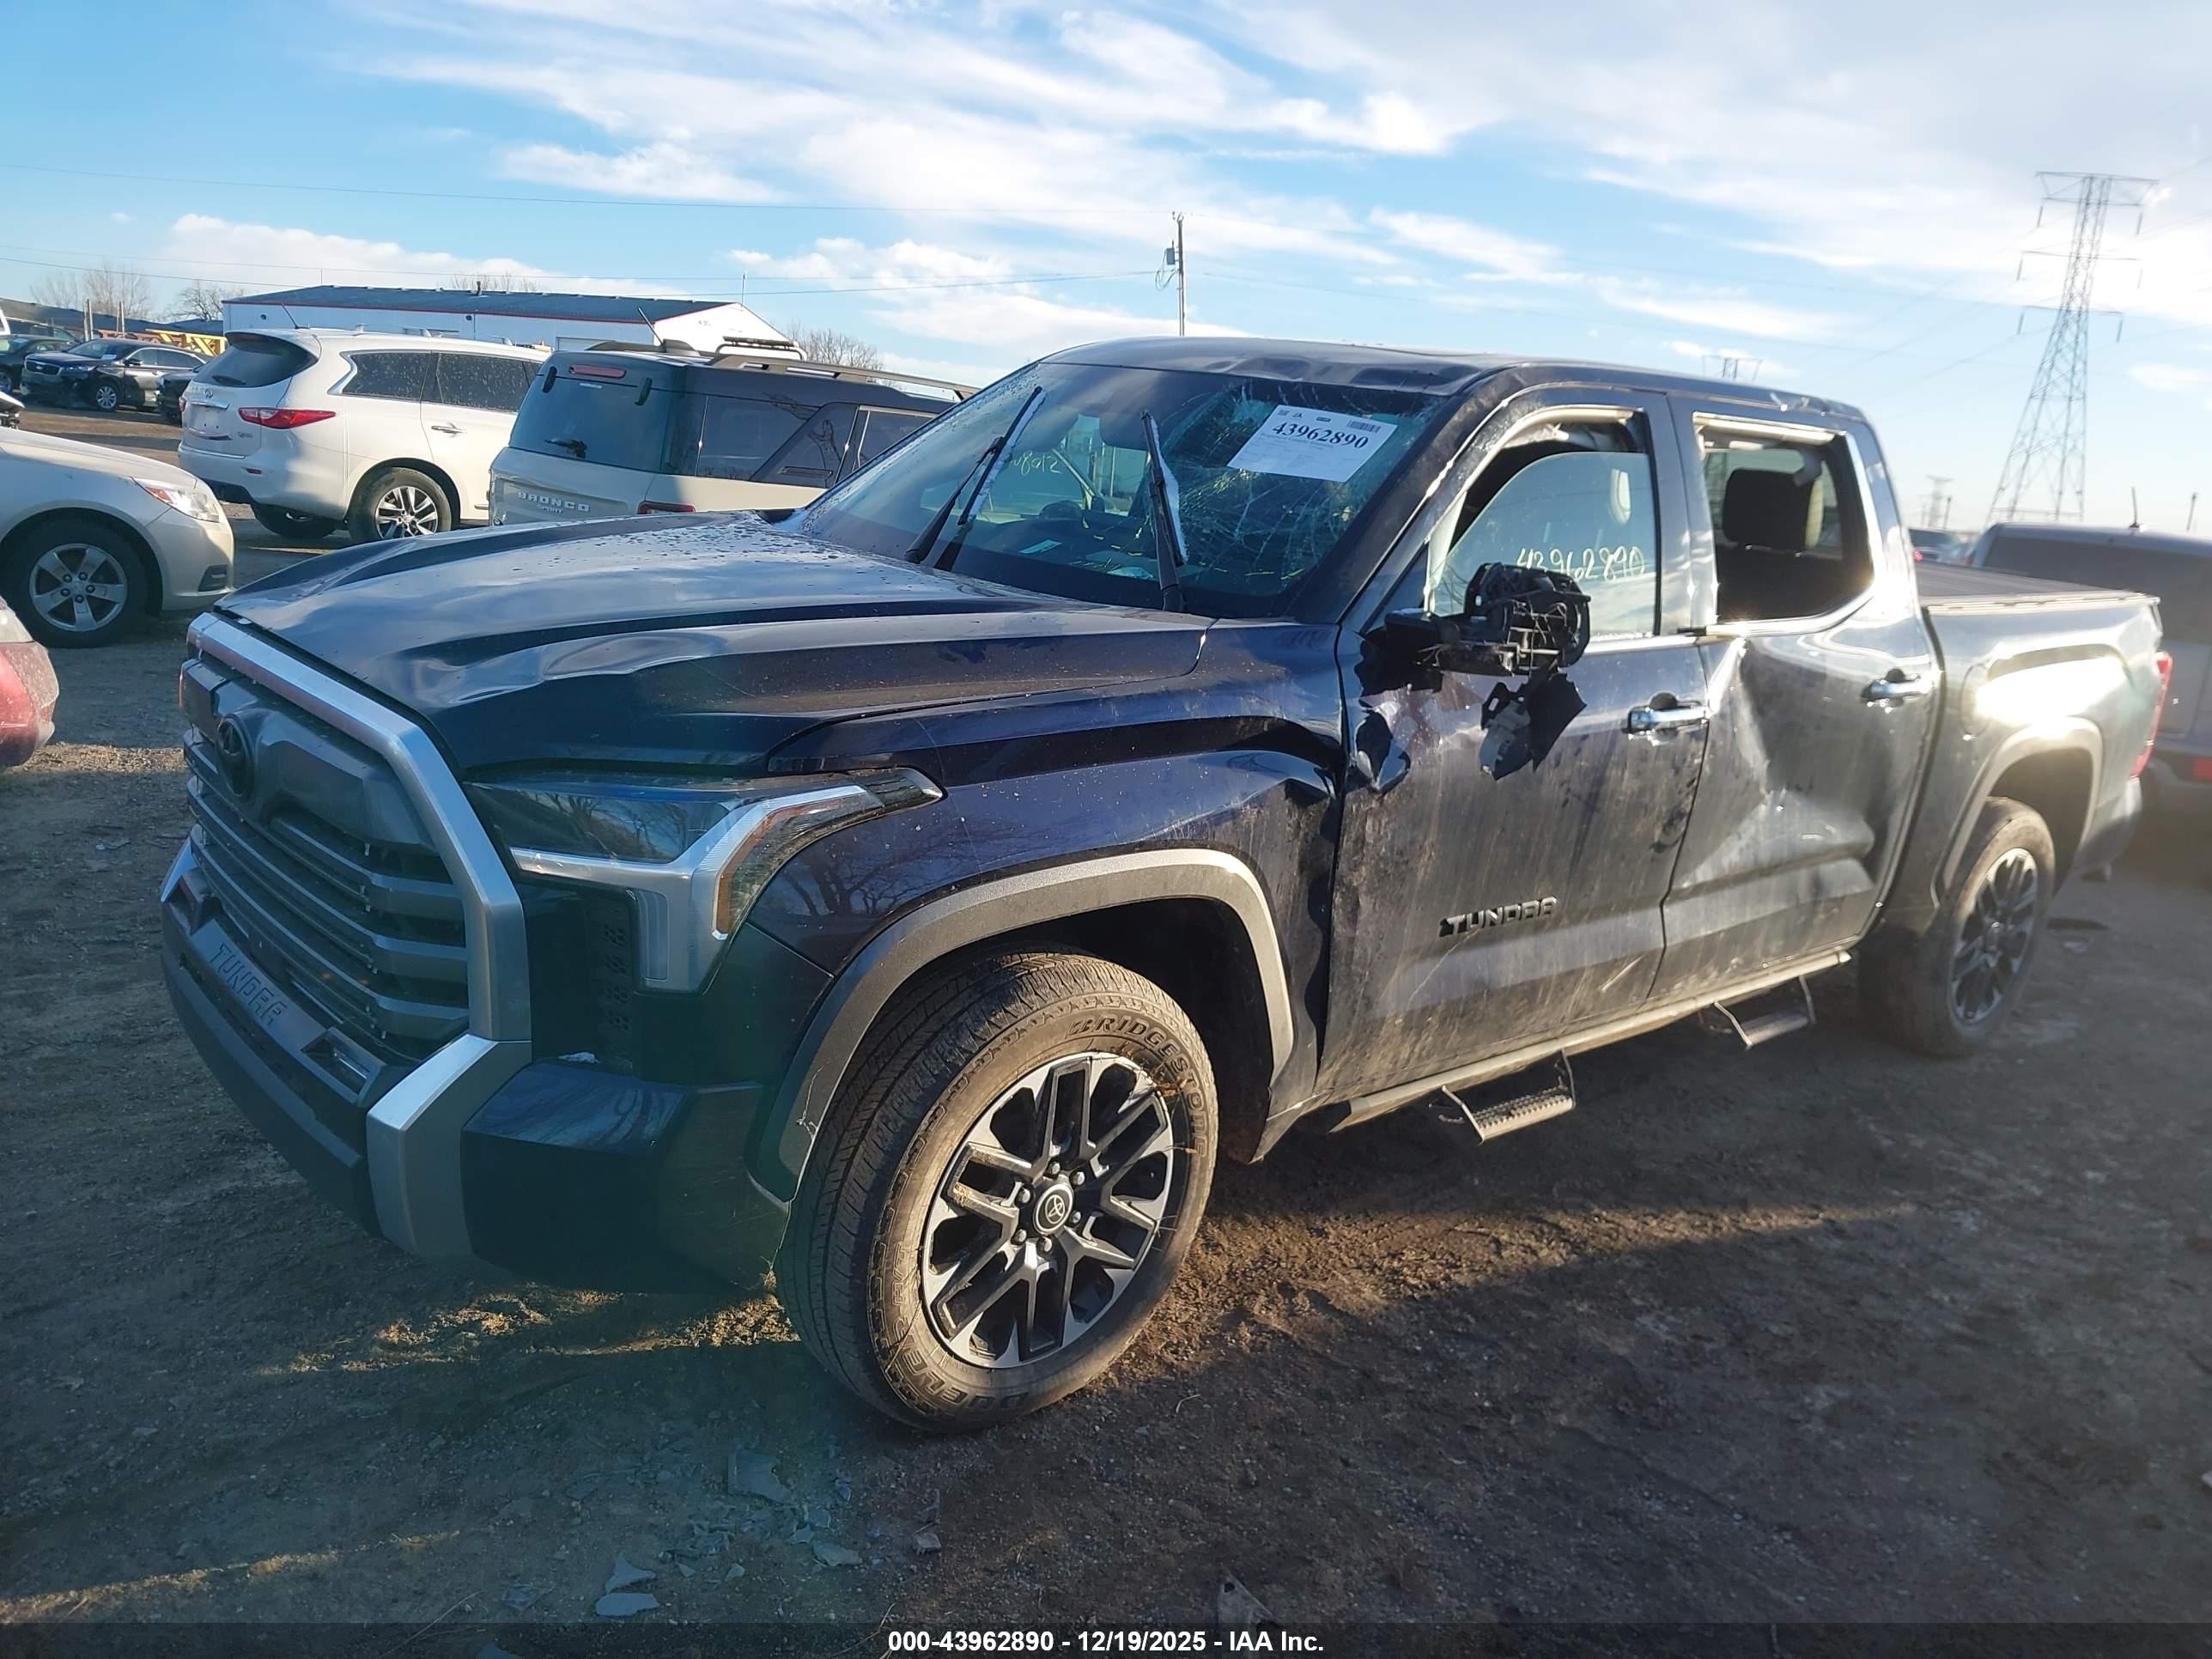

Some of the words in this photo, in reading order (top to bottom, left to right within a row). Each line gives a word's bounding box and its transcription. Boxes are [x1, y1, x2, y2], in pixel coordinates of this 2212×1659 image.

[1273, 422, 1369, 448] 43962890
[518, 491, 590, 512] BRONCO
[1438, 896, 1558, 937] TUNDRA
[209, 943, 288, 1026] TUNDRA
[1066, 1015, 1208, 1159] BRIDGESTONE
